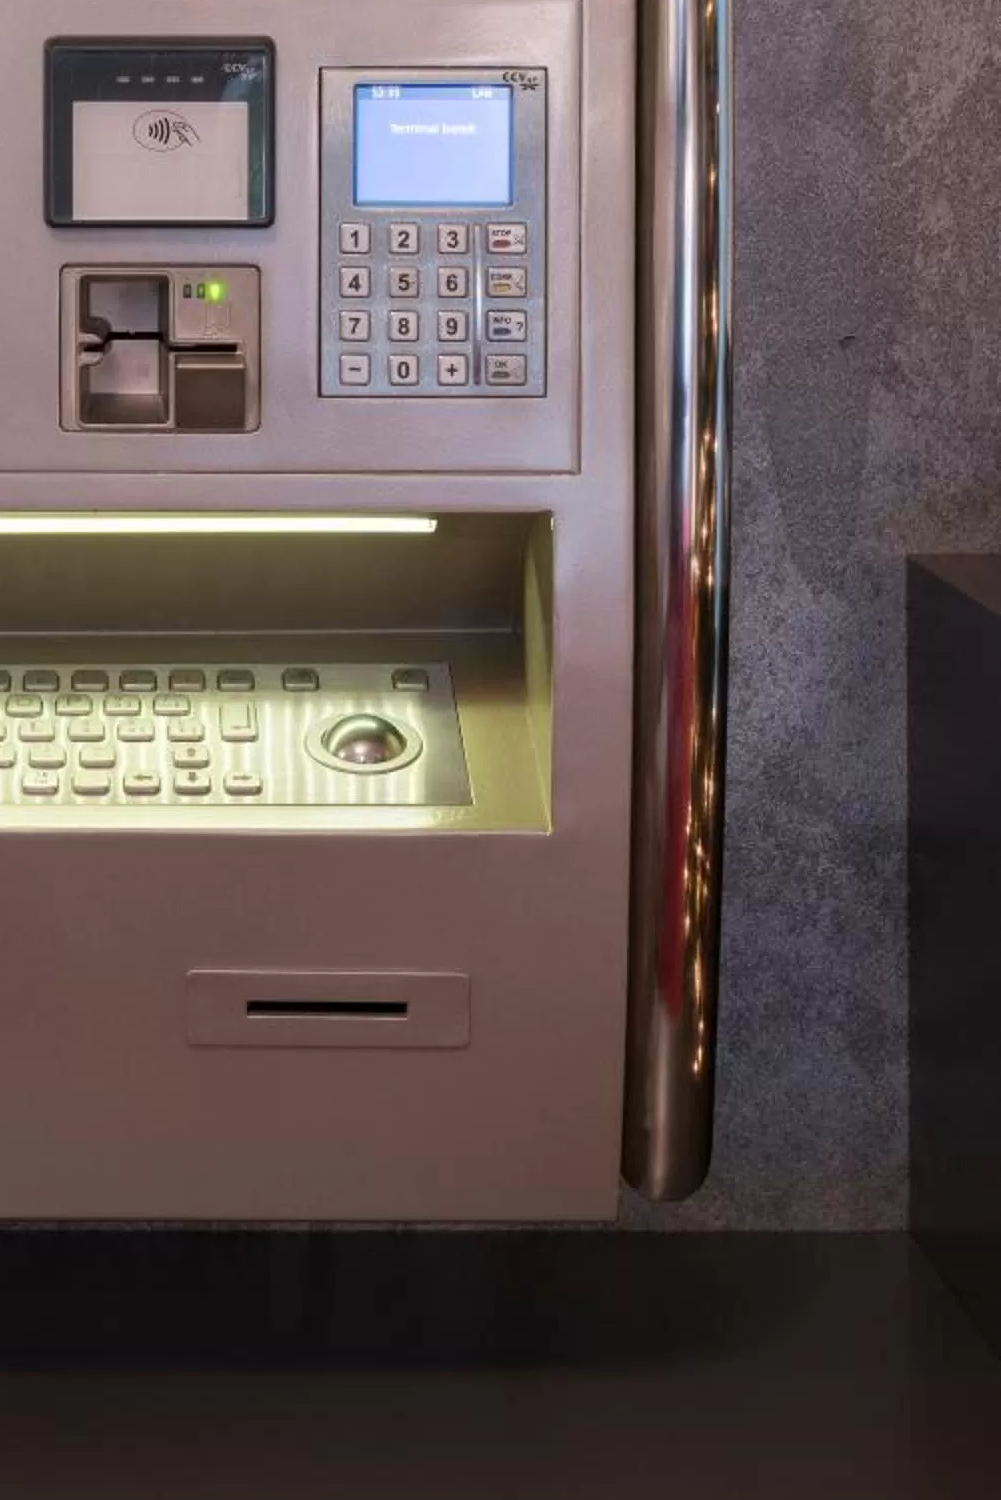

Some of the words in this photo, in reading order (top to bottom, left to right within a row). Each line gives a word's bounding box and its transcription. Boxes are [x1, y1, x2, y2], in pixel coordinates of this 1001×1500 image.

[349, 231, 360, 248] 1
[398, 231, 410, 248] 2
[447, 231, 459, 248] 3
[348, 274, 361, 291] 4
[398, 274, 410, 292] 5
[446, 274, 458, 292] 6
[348, 318, 360, 335] 7
[398, 318, 410, 335] 8
[446, 318, 458, 335] 9
[397, 362, 410, 379] 0
